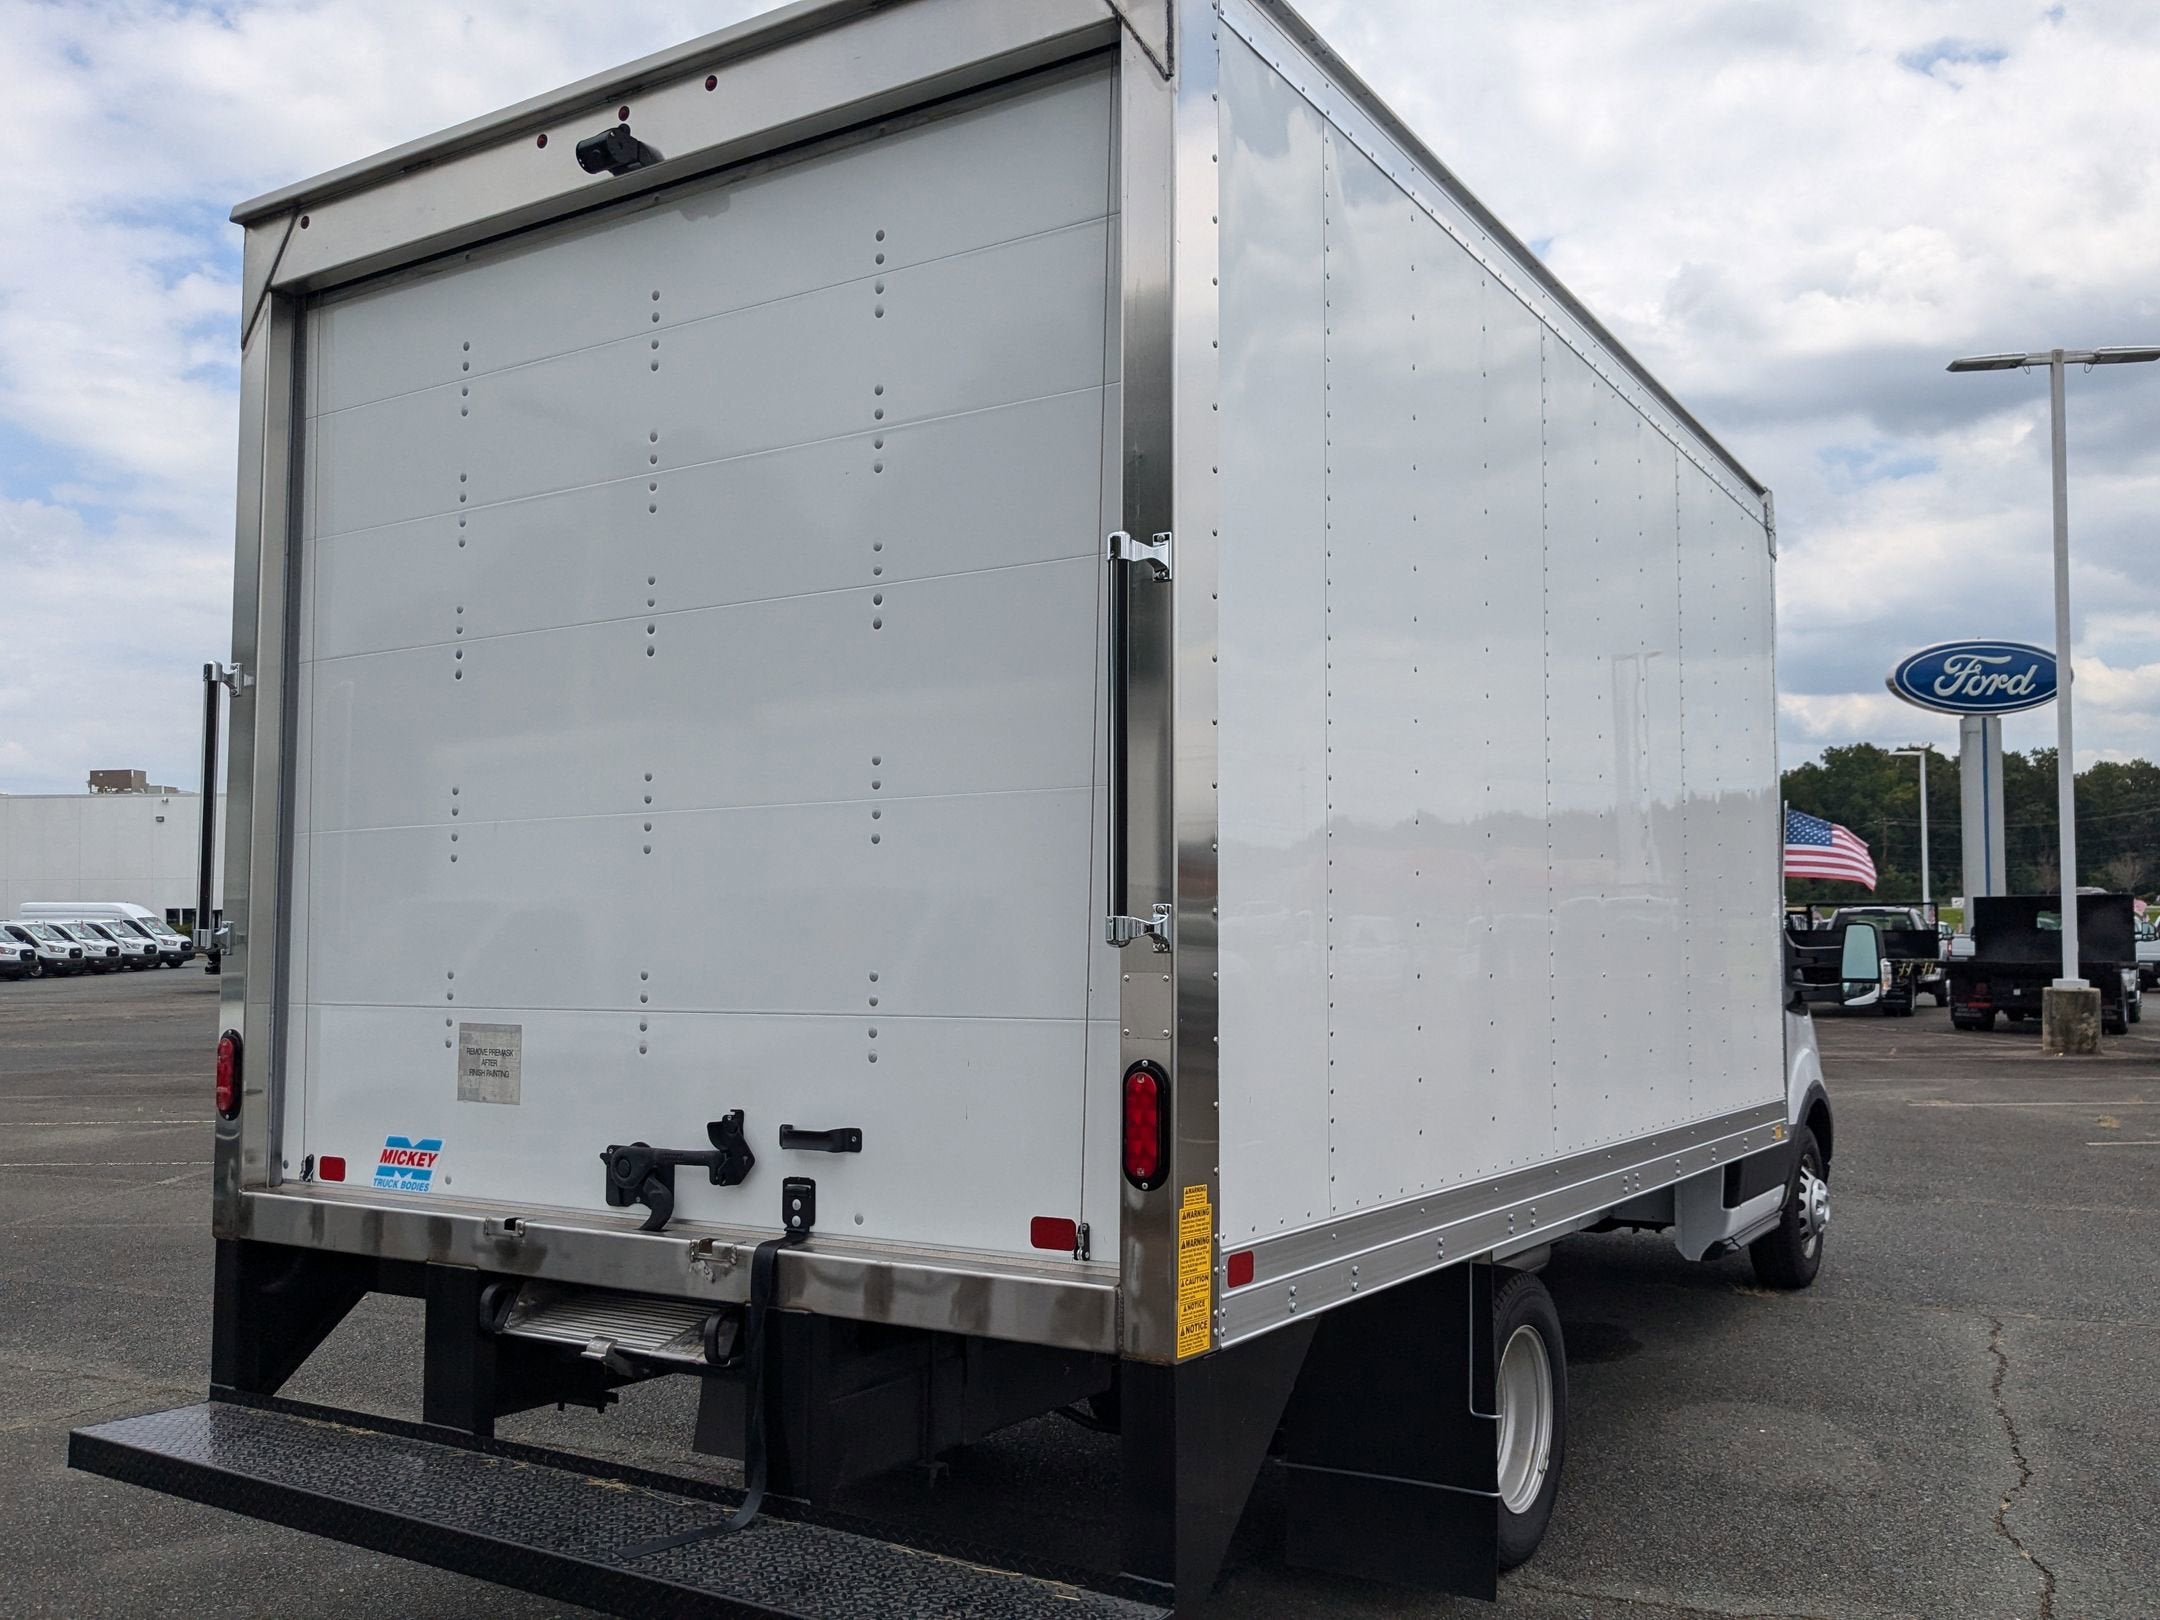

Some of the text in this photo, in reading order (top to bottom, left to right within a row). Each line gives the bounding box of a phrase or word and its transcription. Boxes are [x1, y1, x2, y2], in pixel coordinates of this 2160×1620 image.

[1934, 654, 2038, 697] Ford
[466, 1047, 488, 1056] REMOVE
[481, 1059, 498, 1067] AFTER
[468, 1068, 510, 1078] FINISH PAINTING
[380, 1149, 438, 1168] MICKEY
[373, 1178, 430, 1192] TRUCK BODIES
[1188, 1186, 1206, 1195] WARNING
[1186, 1208, 1209, 1220] WARNING
[1185, 1236, 1210, 1249] WARNING
[1185, 1274, 1209, 1286] CAUTION
[1187, 1299, 1205, 1311] NOTICE
[1185, 1320, 1208, 1334] NOTICE
